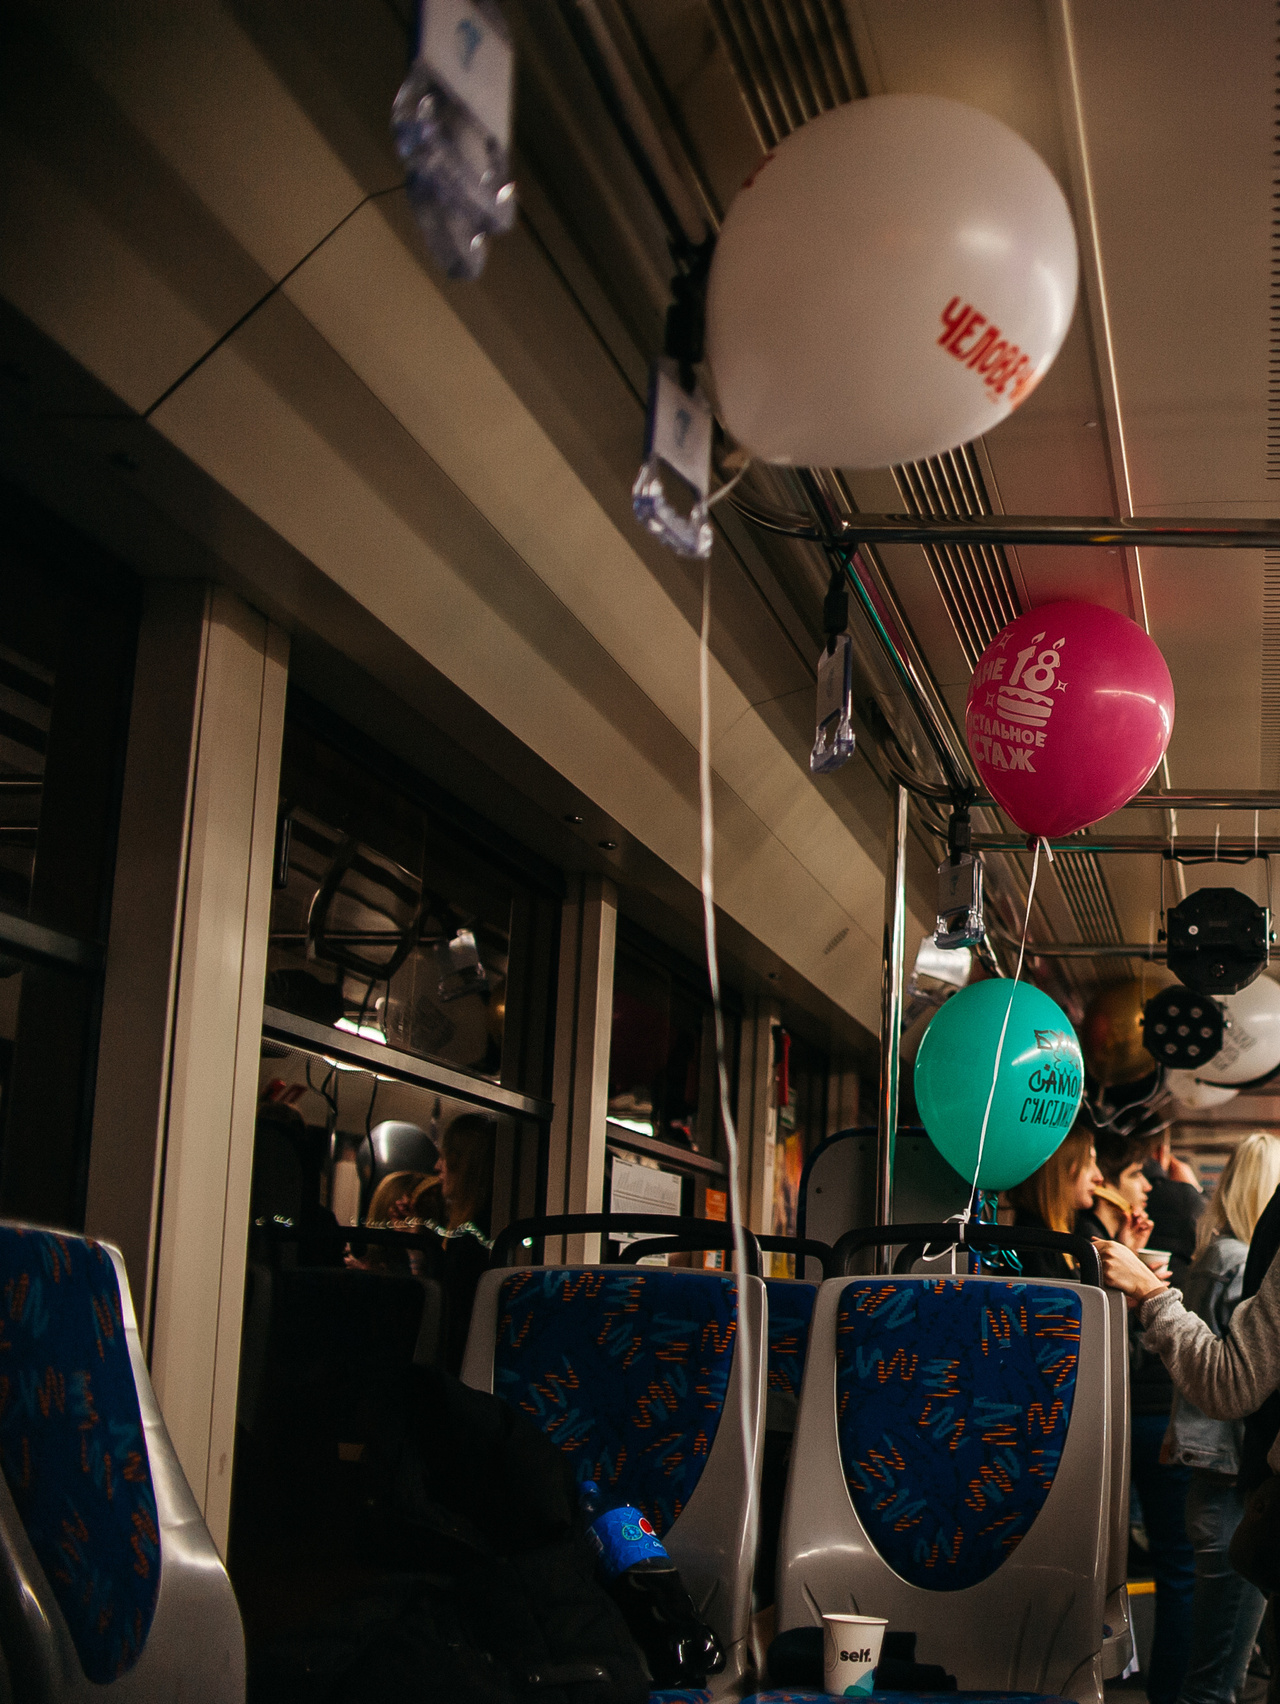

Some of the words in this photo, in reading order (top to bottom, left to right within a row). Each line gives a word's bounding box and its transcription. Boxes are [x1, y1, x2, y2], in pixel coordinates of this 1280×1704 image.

[1009, 645, 1060, 693] 18
[971, 733, 1037, 773] СТАЖ
[1028, 1069, 1082, 1099] САМО
[839, 1648, 872, 1662] self.
